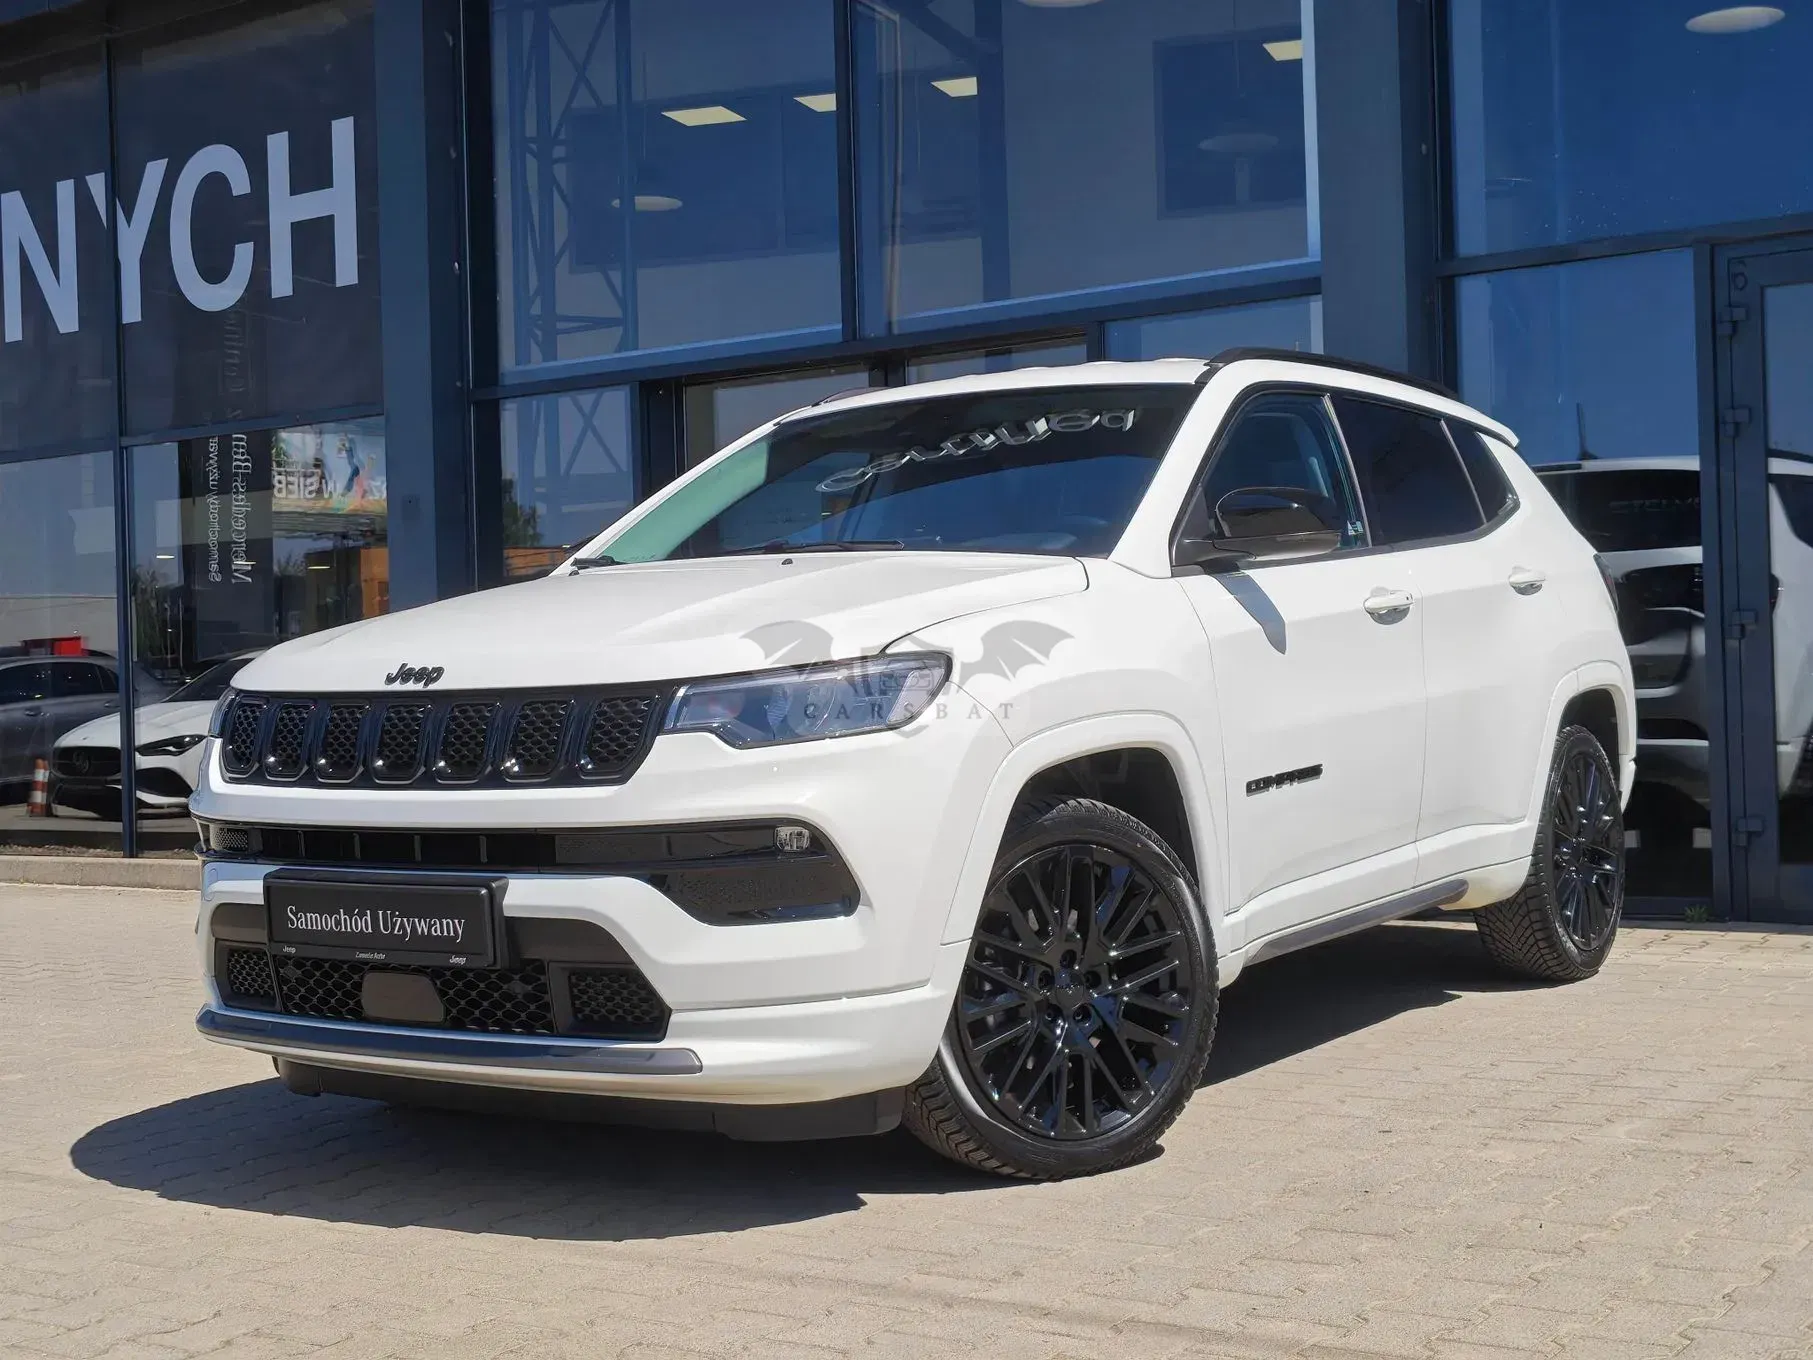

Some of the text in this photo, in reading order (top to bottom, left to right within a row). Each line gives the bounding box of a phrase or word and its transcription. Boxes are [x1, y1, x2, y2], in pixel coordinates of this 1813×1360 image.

[1, 116, 358, 343] NYCH
[384, 662, 445, 688] Jeep
[287, 905, 466, 943] Samochód Używany
